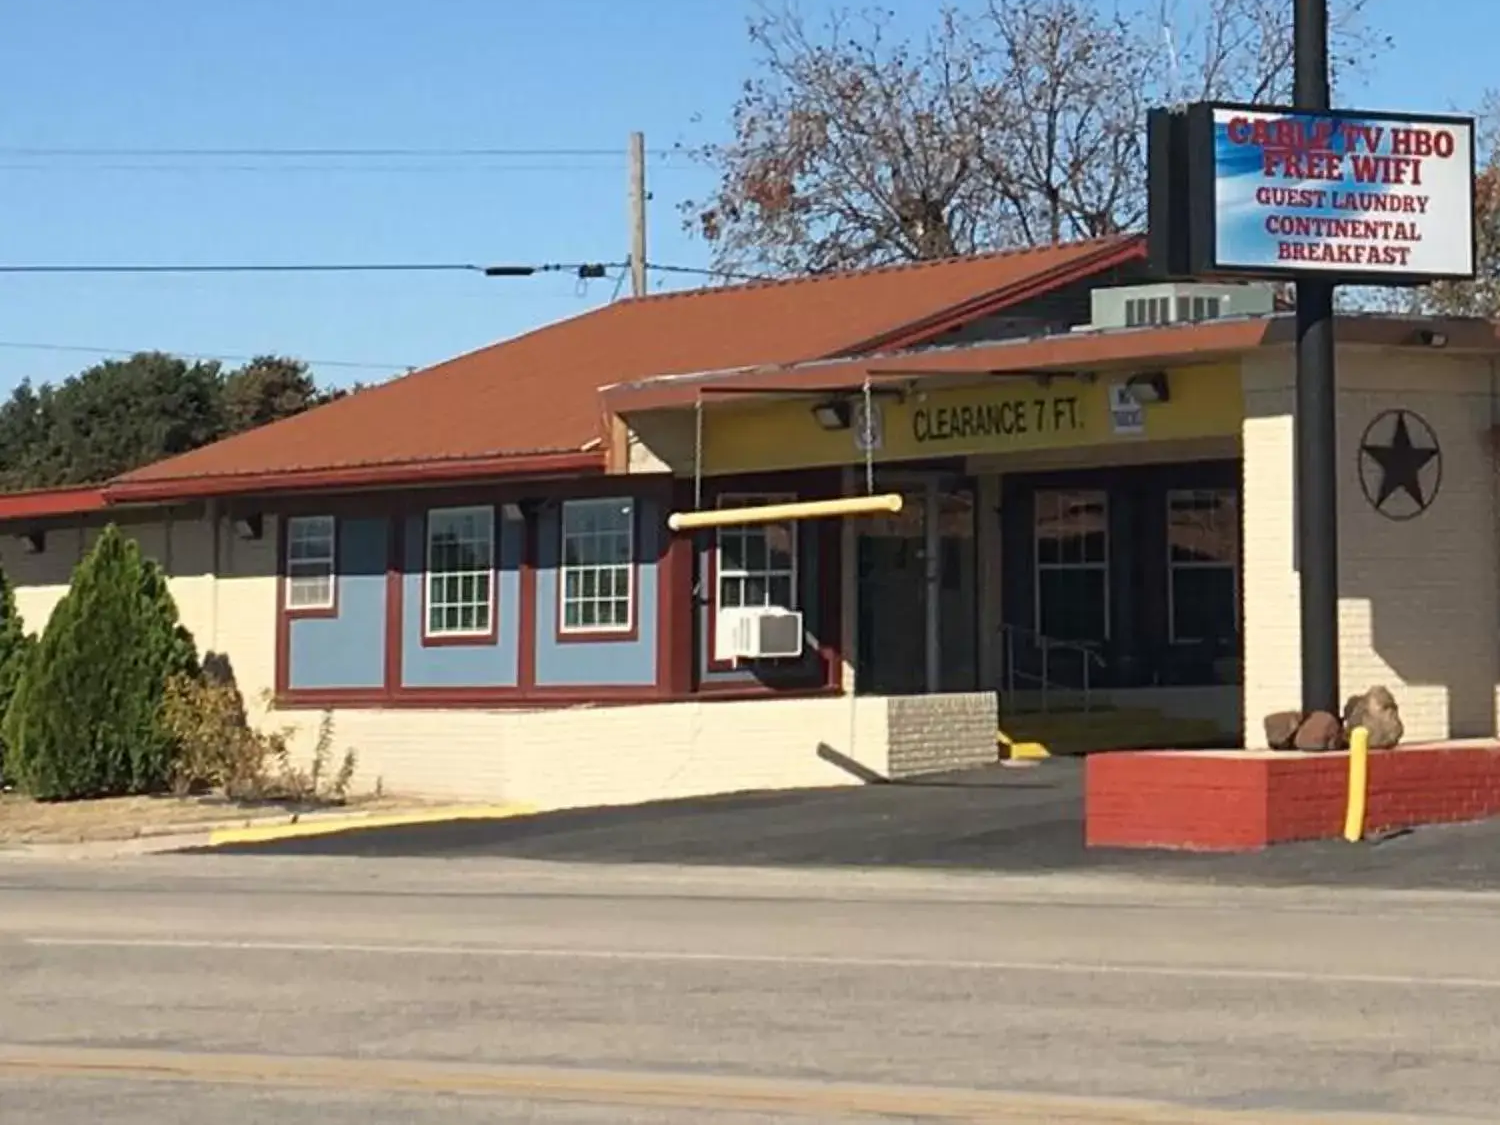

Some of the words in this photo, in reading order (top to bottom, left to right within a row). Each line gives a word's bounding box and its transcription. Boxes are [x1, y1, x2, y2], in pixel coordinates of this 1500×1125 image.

[1227, 116, 1334, 149] CABLE
[1341, 126, 1384, 155] TV
[1391, 127, 1455, 159] HBO
[1263, 149, 1344, 181] FREE
[1350, 155, 1423, 186] WIFI
[1255, 186, 1327, 208] GUEST
[1332, 190, 1430, 214] LAUNDRY
[1265, 214, 1422, 242] CONTINENTAL
[1277, 241, 1411, 266] BREAKFAST
[912, 399, 1028, 444] CLEARANCE
[1033, 399, 1046, 433] 7
